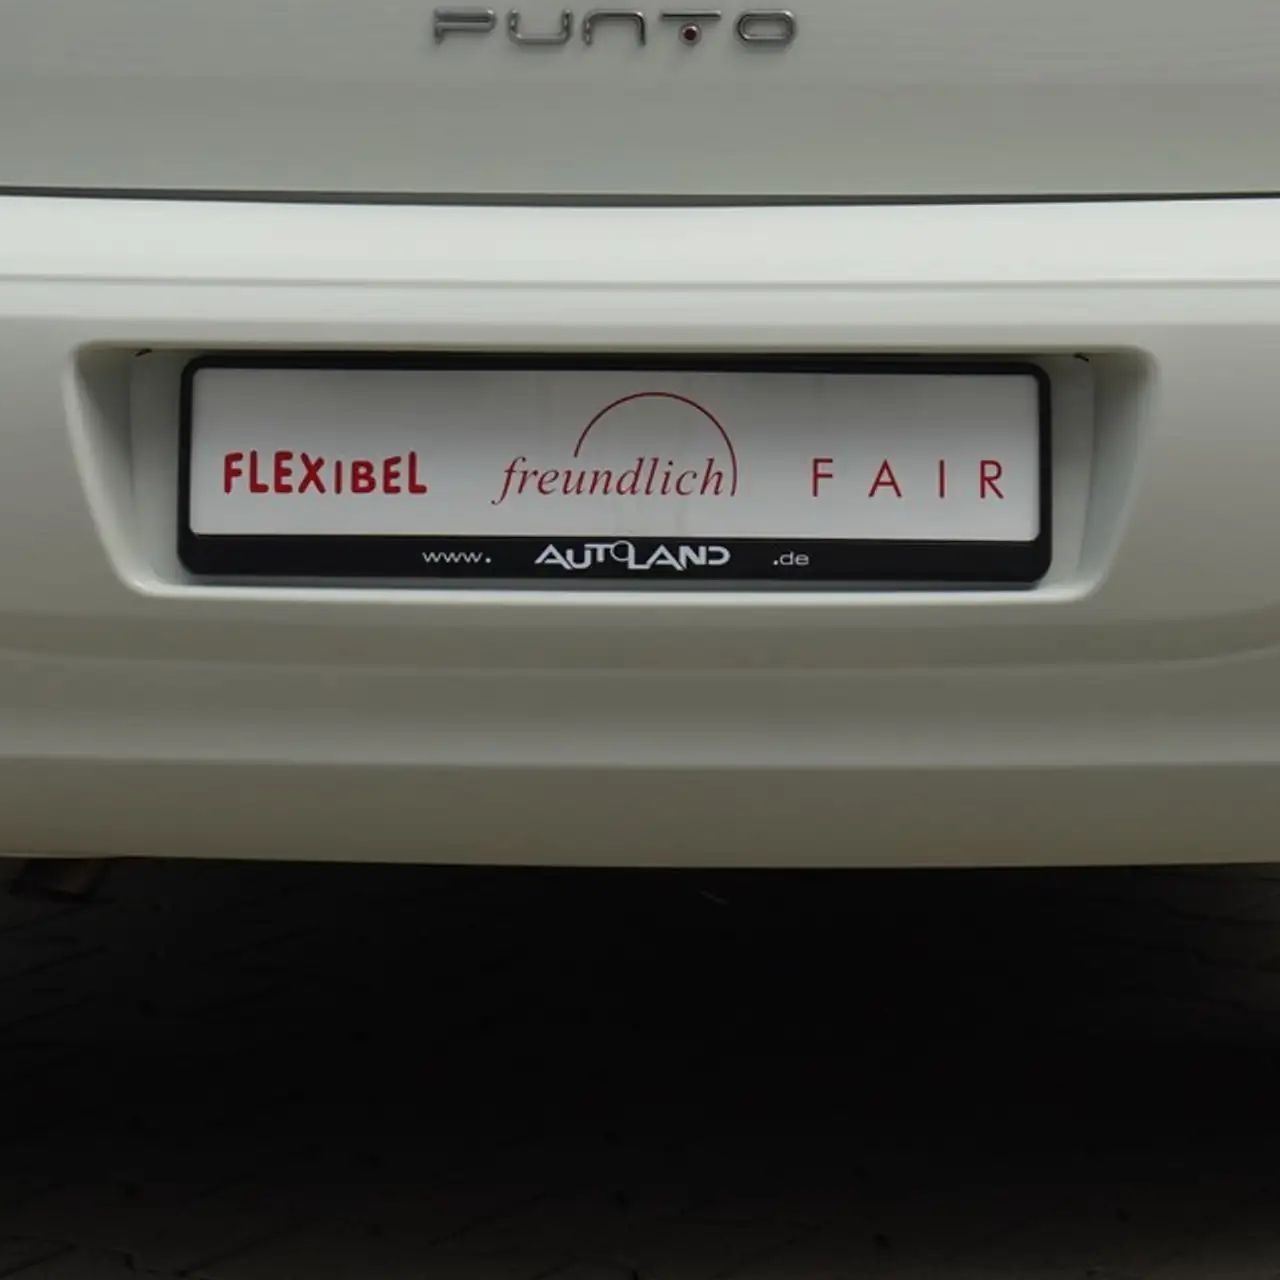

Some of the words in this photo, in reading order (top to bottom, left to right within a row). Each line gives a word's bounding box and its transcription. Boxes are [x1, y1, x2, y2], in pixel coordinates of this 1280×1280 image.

[432, 6, 797, 47] PUNTO
[223, 449, 428, 496] FLEXIBEL
[490, 456, 725, 506] freundlich
[533, 539, 732, 572] AUTOLAND
